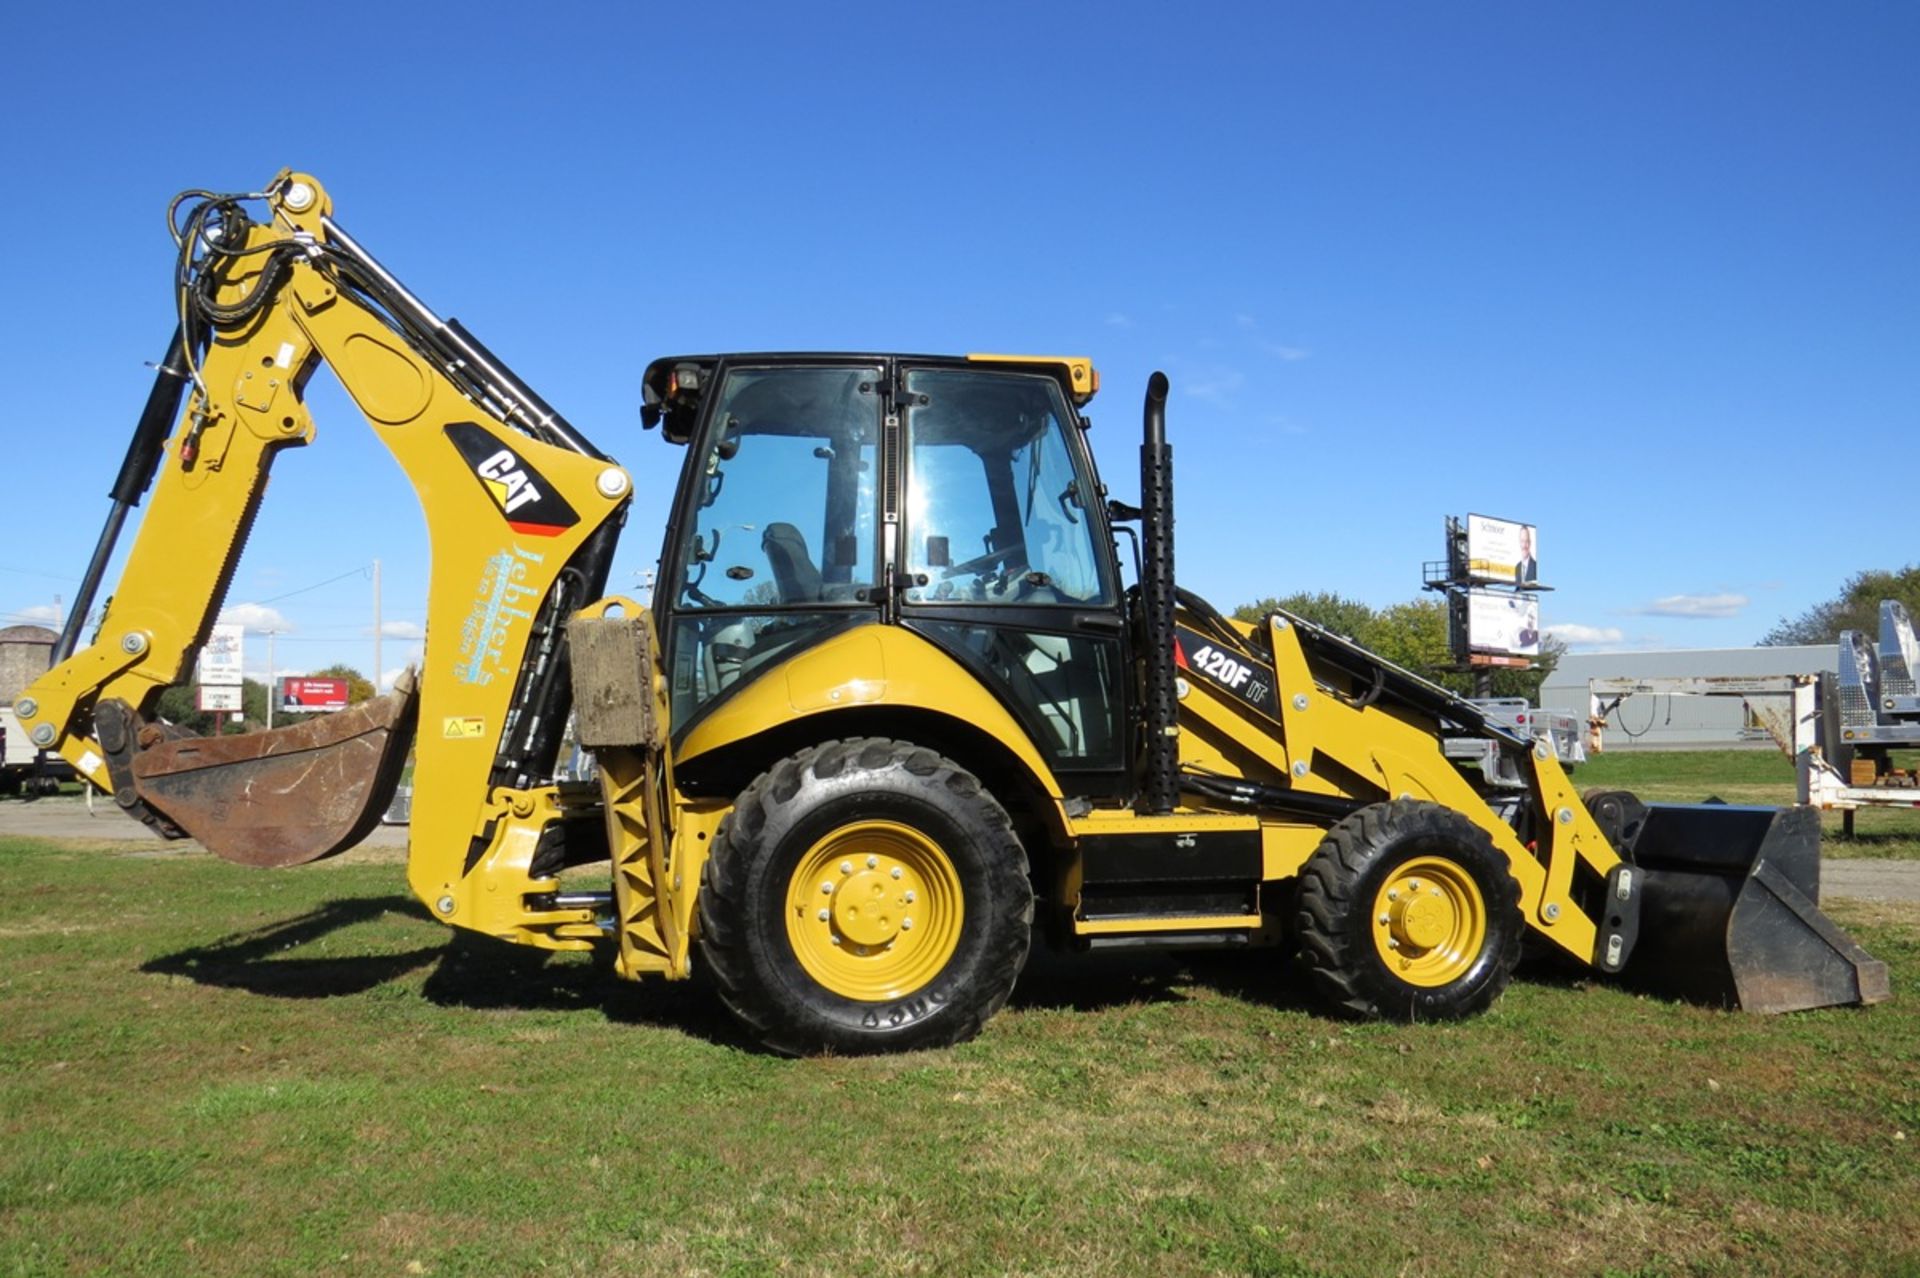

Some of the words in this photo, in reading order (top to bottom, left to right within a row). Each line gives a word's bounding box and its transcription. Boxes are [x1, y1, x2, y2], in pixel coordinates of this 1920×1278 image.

[478, 449, 541, 514] CAT
[1192, 645, 1252, 688] 420F
[1246, 680, 1269, 703] IT
